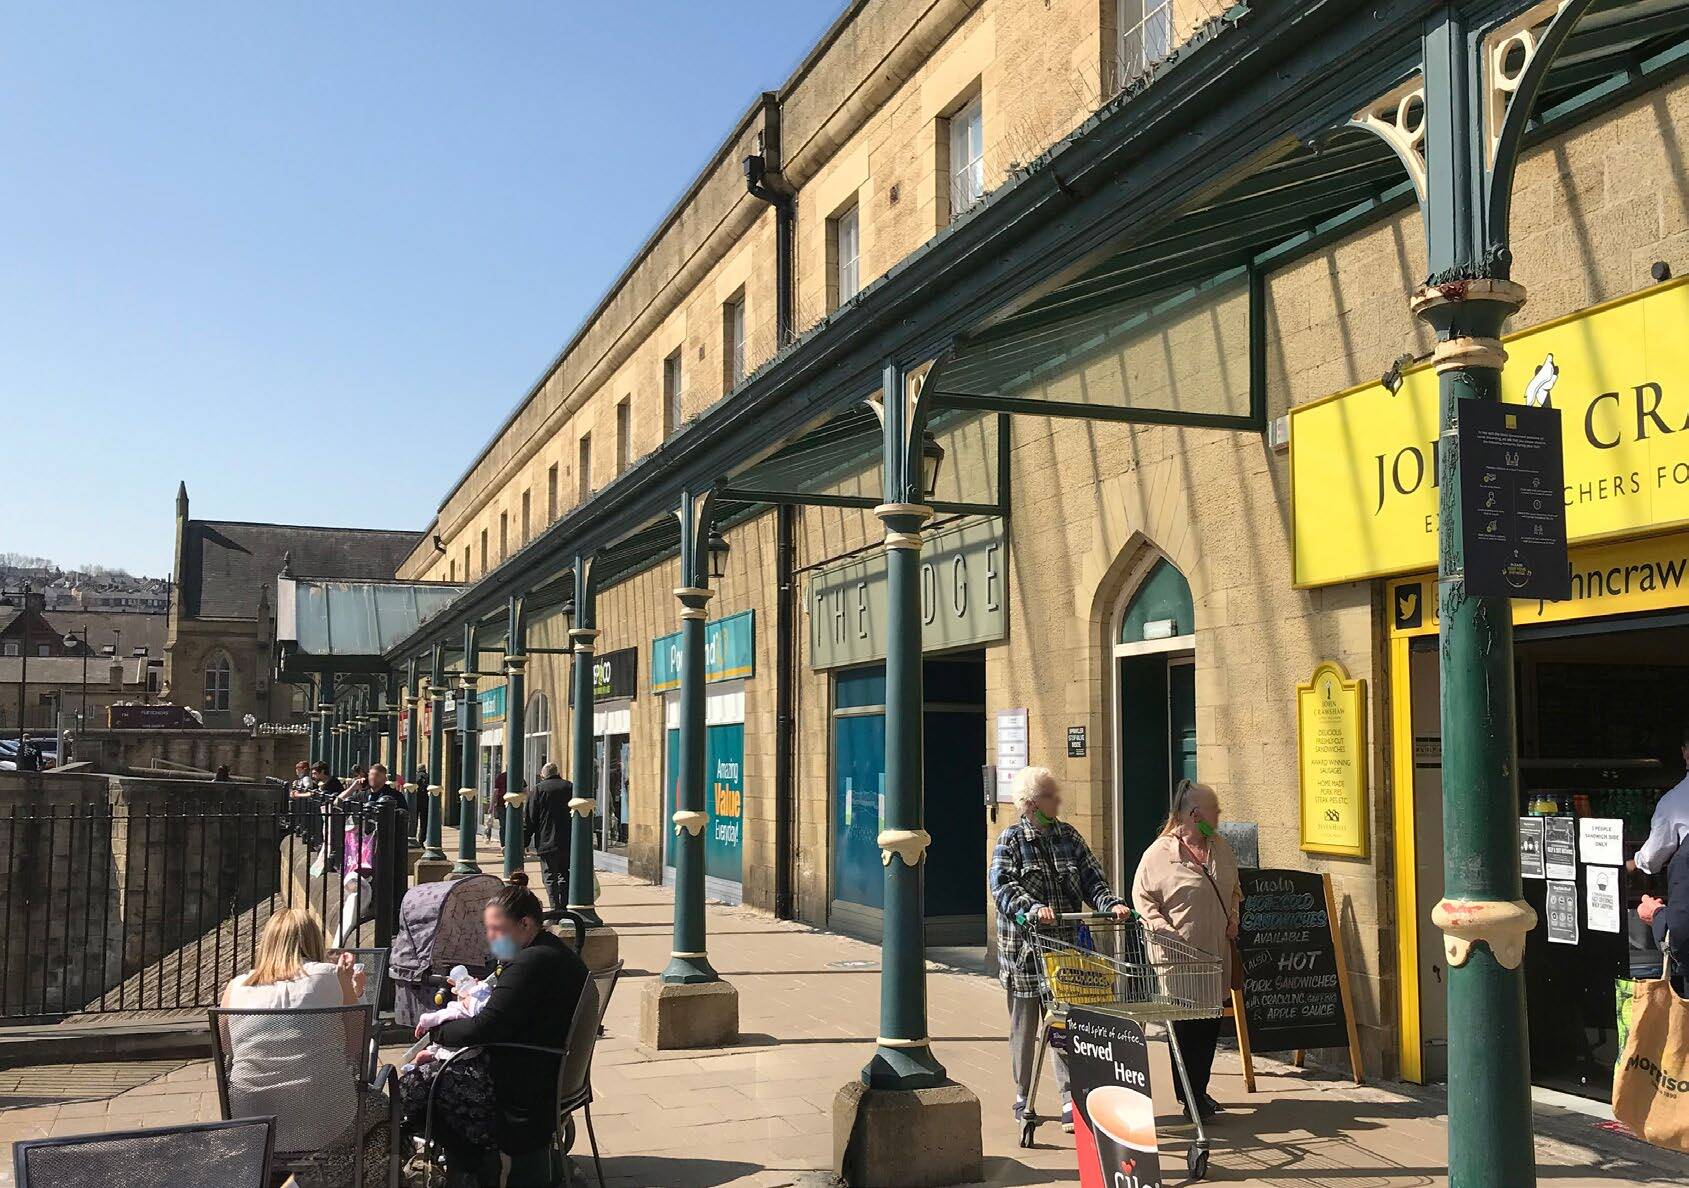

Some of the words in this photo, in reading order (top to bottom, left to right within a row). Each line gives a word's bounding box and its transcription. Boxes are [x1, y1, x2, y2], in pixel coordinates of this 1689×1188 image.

[1374, 440, 1440, 517] JO
[1657, 462, 1689, 489] FO
[815, 581, 868, 649] THE
[920, 542, 1001, 627] DGE
[716, 758, 739, 785] Amazing
[714, 782, 741, 818] Value
[1253, 931, 1310, 944] AVAILABLE
[1278, 950, 1323, 971] HOT
[1244, 978, 1273, 995] PORK
[1275, 974, 1337, 991] SANDWICHES
[1267, 1007, 1297, 1020] APPLE
[1301, 1003, 1336, 1017] SAUCE
[1067, 1018, 1077, 1031] The
[1078, 1022, 1090, 1034] real
[1073, 1035, 1113, 1062] Served
[1114, 1061, 1146, 1088] Here
